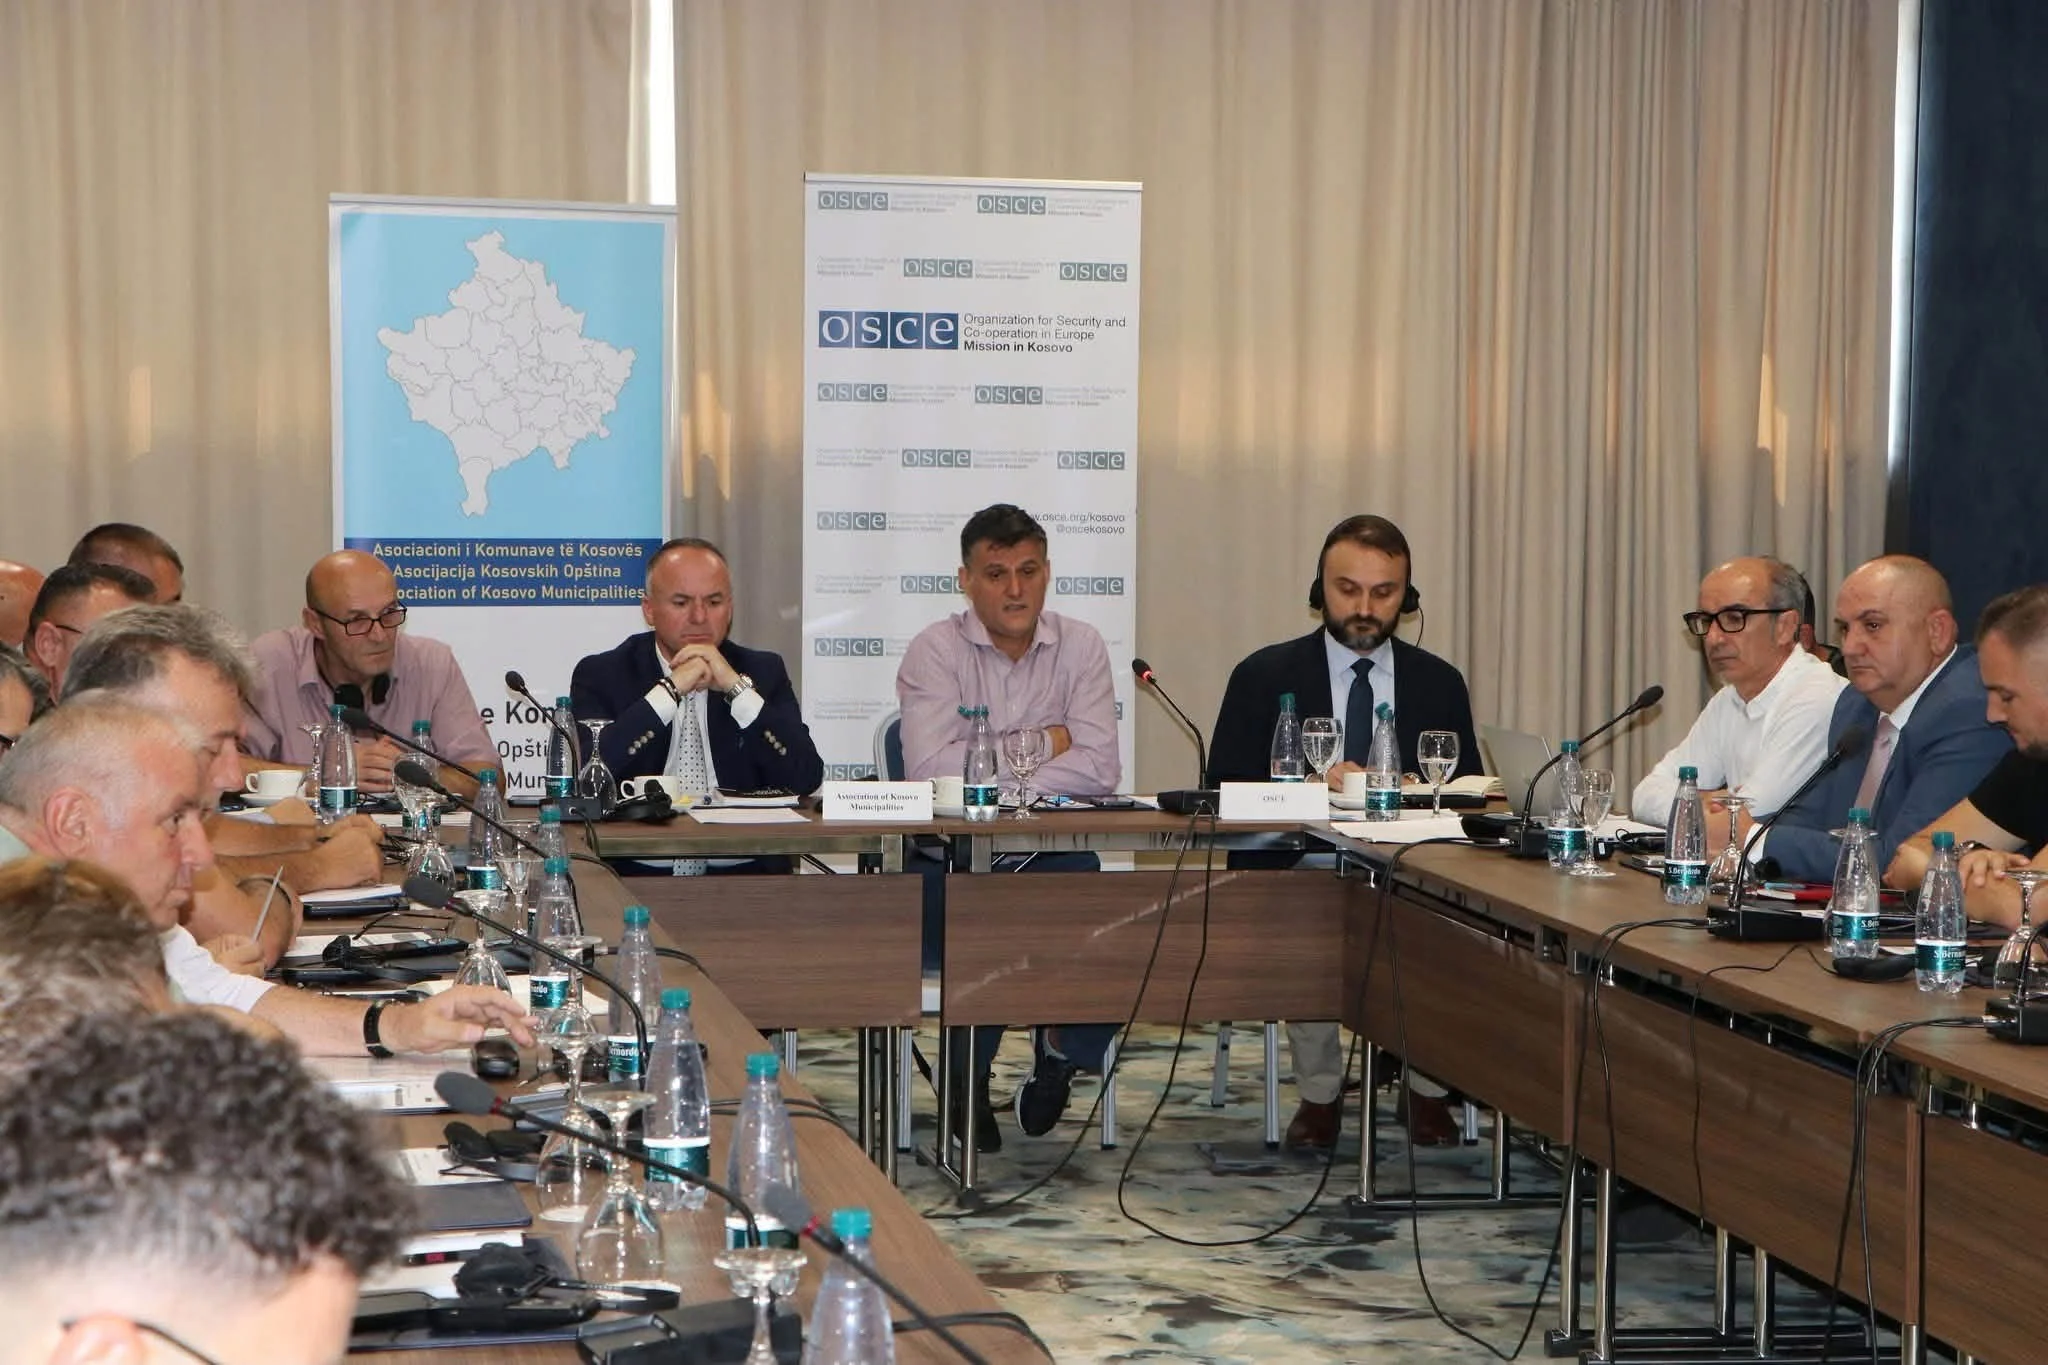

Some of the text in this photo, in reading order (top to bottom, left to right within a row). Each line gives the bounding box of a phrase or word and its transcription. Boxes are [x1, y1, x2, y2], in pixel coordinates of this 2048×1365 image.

[818, 191, 888, 210] osce
[978, 195, 1046, 215] osce
[904, 259, 973, 278] osce
[1060, 262, 1127, 282] osce
[819, 311, 958, 349] osce
[964, 314, 1126, 330] Organization for Security and
[964, 327, 1095, 342] Co-operation in Europe
[964, 341, 1073, 353] Mission in Kosovo
[818, 383, 887, 402] osce
[975, 385, 1043, 405] osce
[902, 448, 971, 468] osce
[1057, 451, 1125, 470] osce
[817, 512, 886, 530] osce
[373, 543, 642, 557] Asociacioni i Komunave të Kosovës
[393, 564, 621, 581] Asocijacija Kosovskih Opština
[462, 585, 476, 600] of
[481, 586, 536, 600] Kosovo
[542, 585, 645, 601] Municipalities
[1056, 577, 1123, 595] osce
[816, 638, 883, 656] osce
[836, 793, 919, 801] Association of Kosovo
[850, 803, 904, 812] Municipalities
